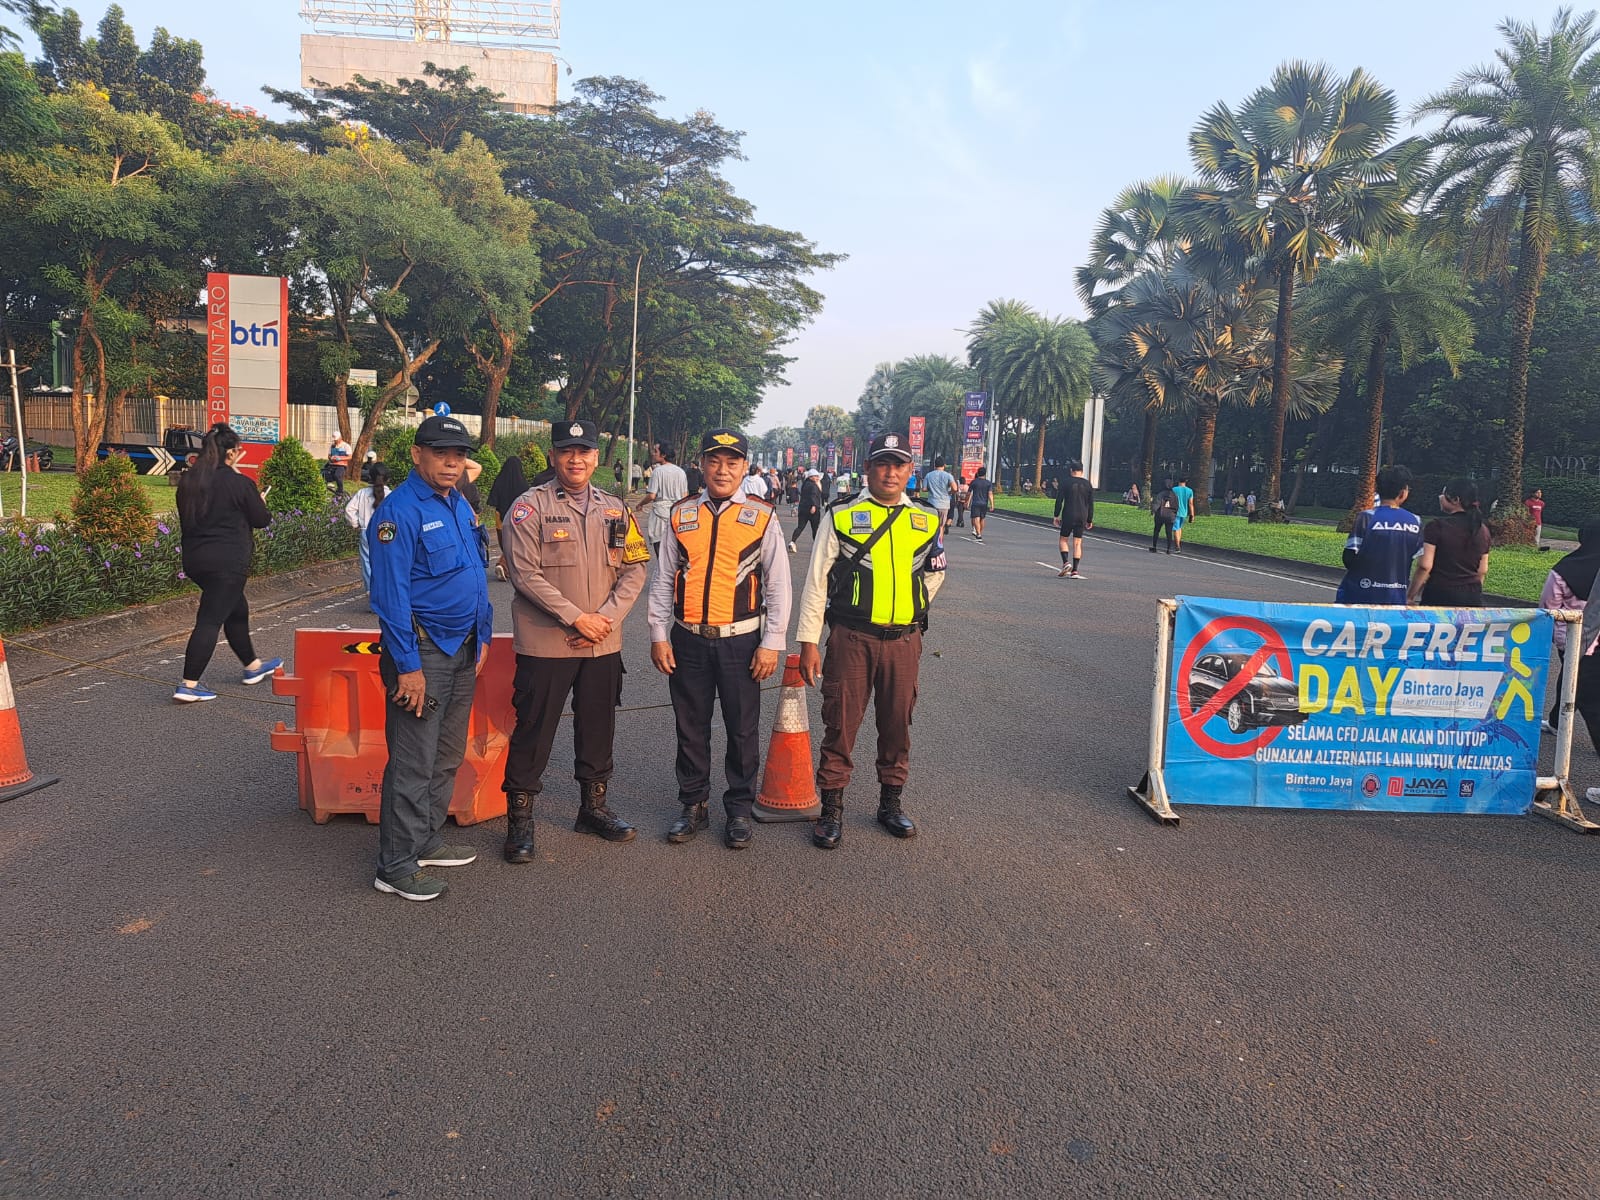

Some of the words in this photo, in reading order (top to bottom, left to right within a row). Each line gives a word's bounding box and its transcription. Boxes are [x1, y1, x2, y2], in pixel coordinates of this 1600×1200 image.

[211, 286, 226, 375] BINTARO
[231, 320, 278, 347] btn
[211, 385, 226, 424] CBD
[545, 516, 571, 524] NASIR
[1371, 521, 1420, 534] ALAND
[1301, 618, 1392, 660] CAR
[1398, 622, 1512, 663] FREE
[1297, 663, 1401, 716] DAY
[1402, 680, 1453, 697] Bintaro
[1455, 682, 1485, 700] Jaya
[1287, 725, 1334, 741] SELAMA
[1336, 726, 1359, 742] CFD
[1360, 727, 1399, 743] JALAN
[1400, 728, 1434, 745] AKAN
[1437, 730, 1488, 747] DITUTUP
[1255, 747, 1313, 764] GUNAKAN
[1314, 749, 1383, 767] ALTERNATIF
[1385, 751, 1413, 768] LAIN
[1416, 753, 1455, 769] UNTUK
[1456, 755, 1513, 771] MELINTAS
[1285, 773, 1327, 786] Bintaro
[1328, 775, 1353, 788] Jaya
[1405, 777, 1449, 790] JAYA
